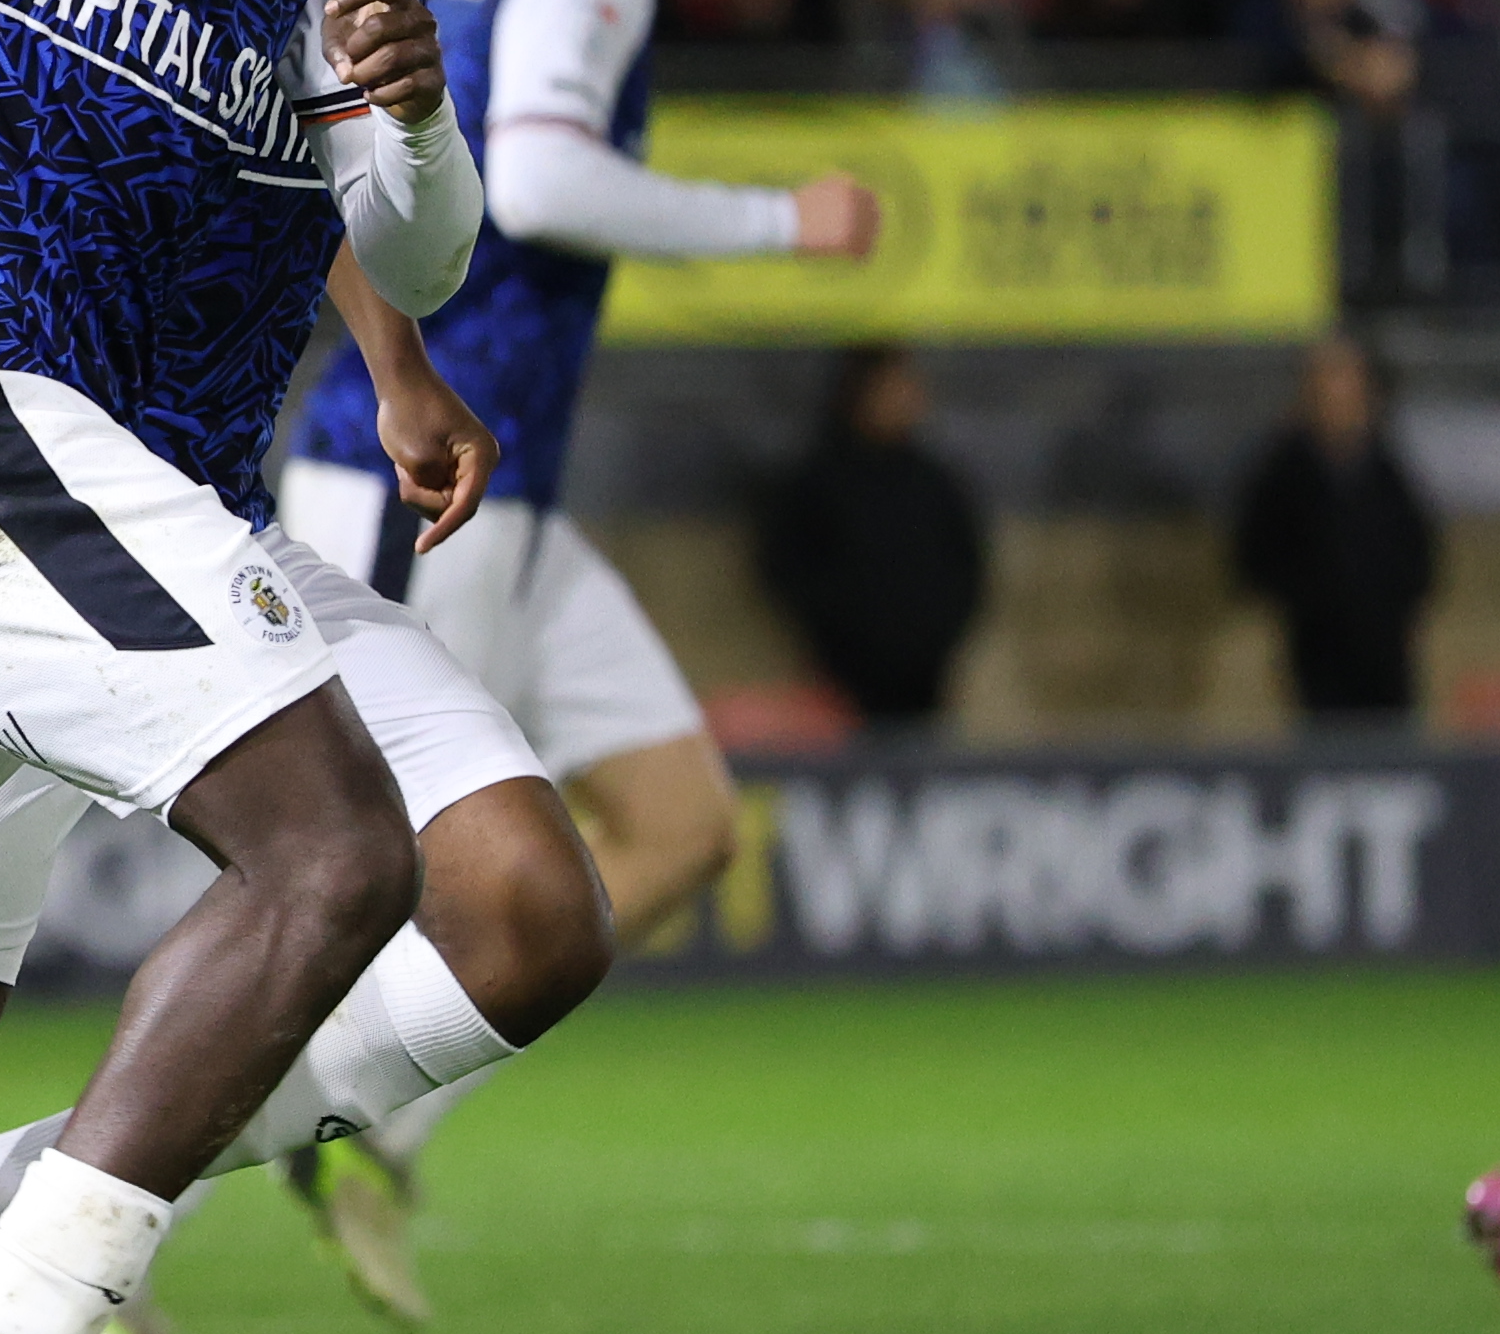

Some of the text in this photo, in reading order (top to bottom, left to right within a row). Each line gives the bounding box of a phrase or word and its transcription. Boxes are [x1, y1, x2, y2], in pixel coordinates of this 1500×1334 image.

[230, 565, 272, 604] LUTON TOWN
[262, 627, 300, 643] FOOTBALL
